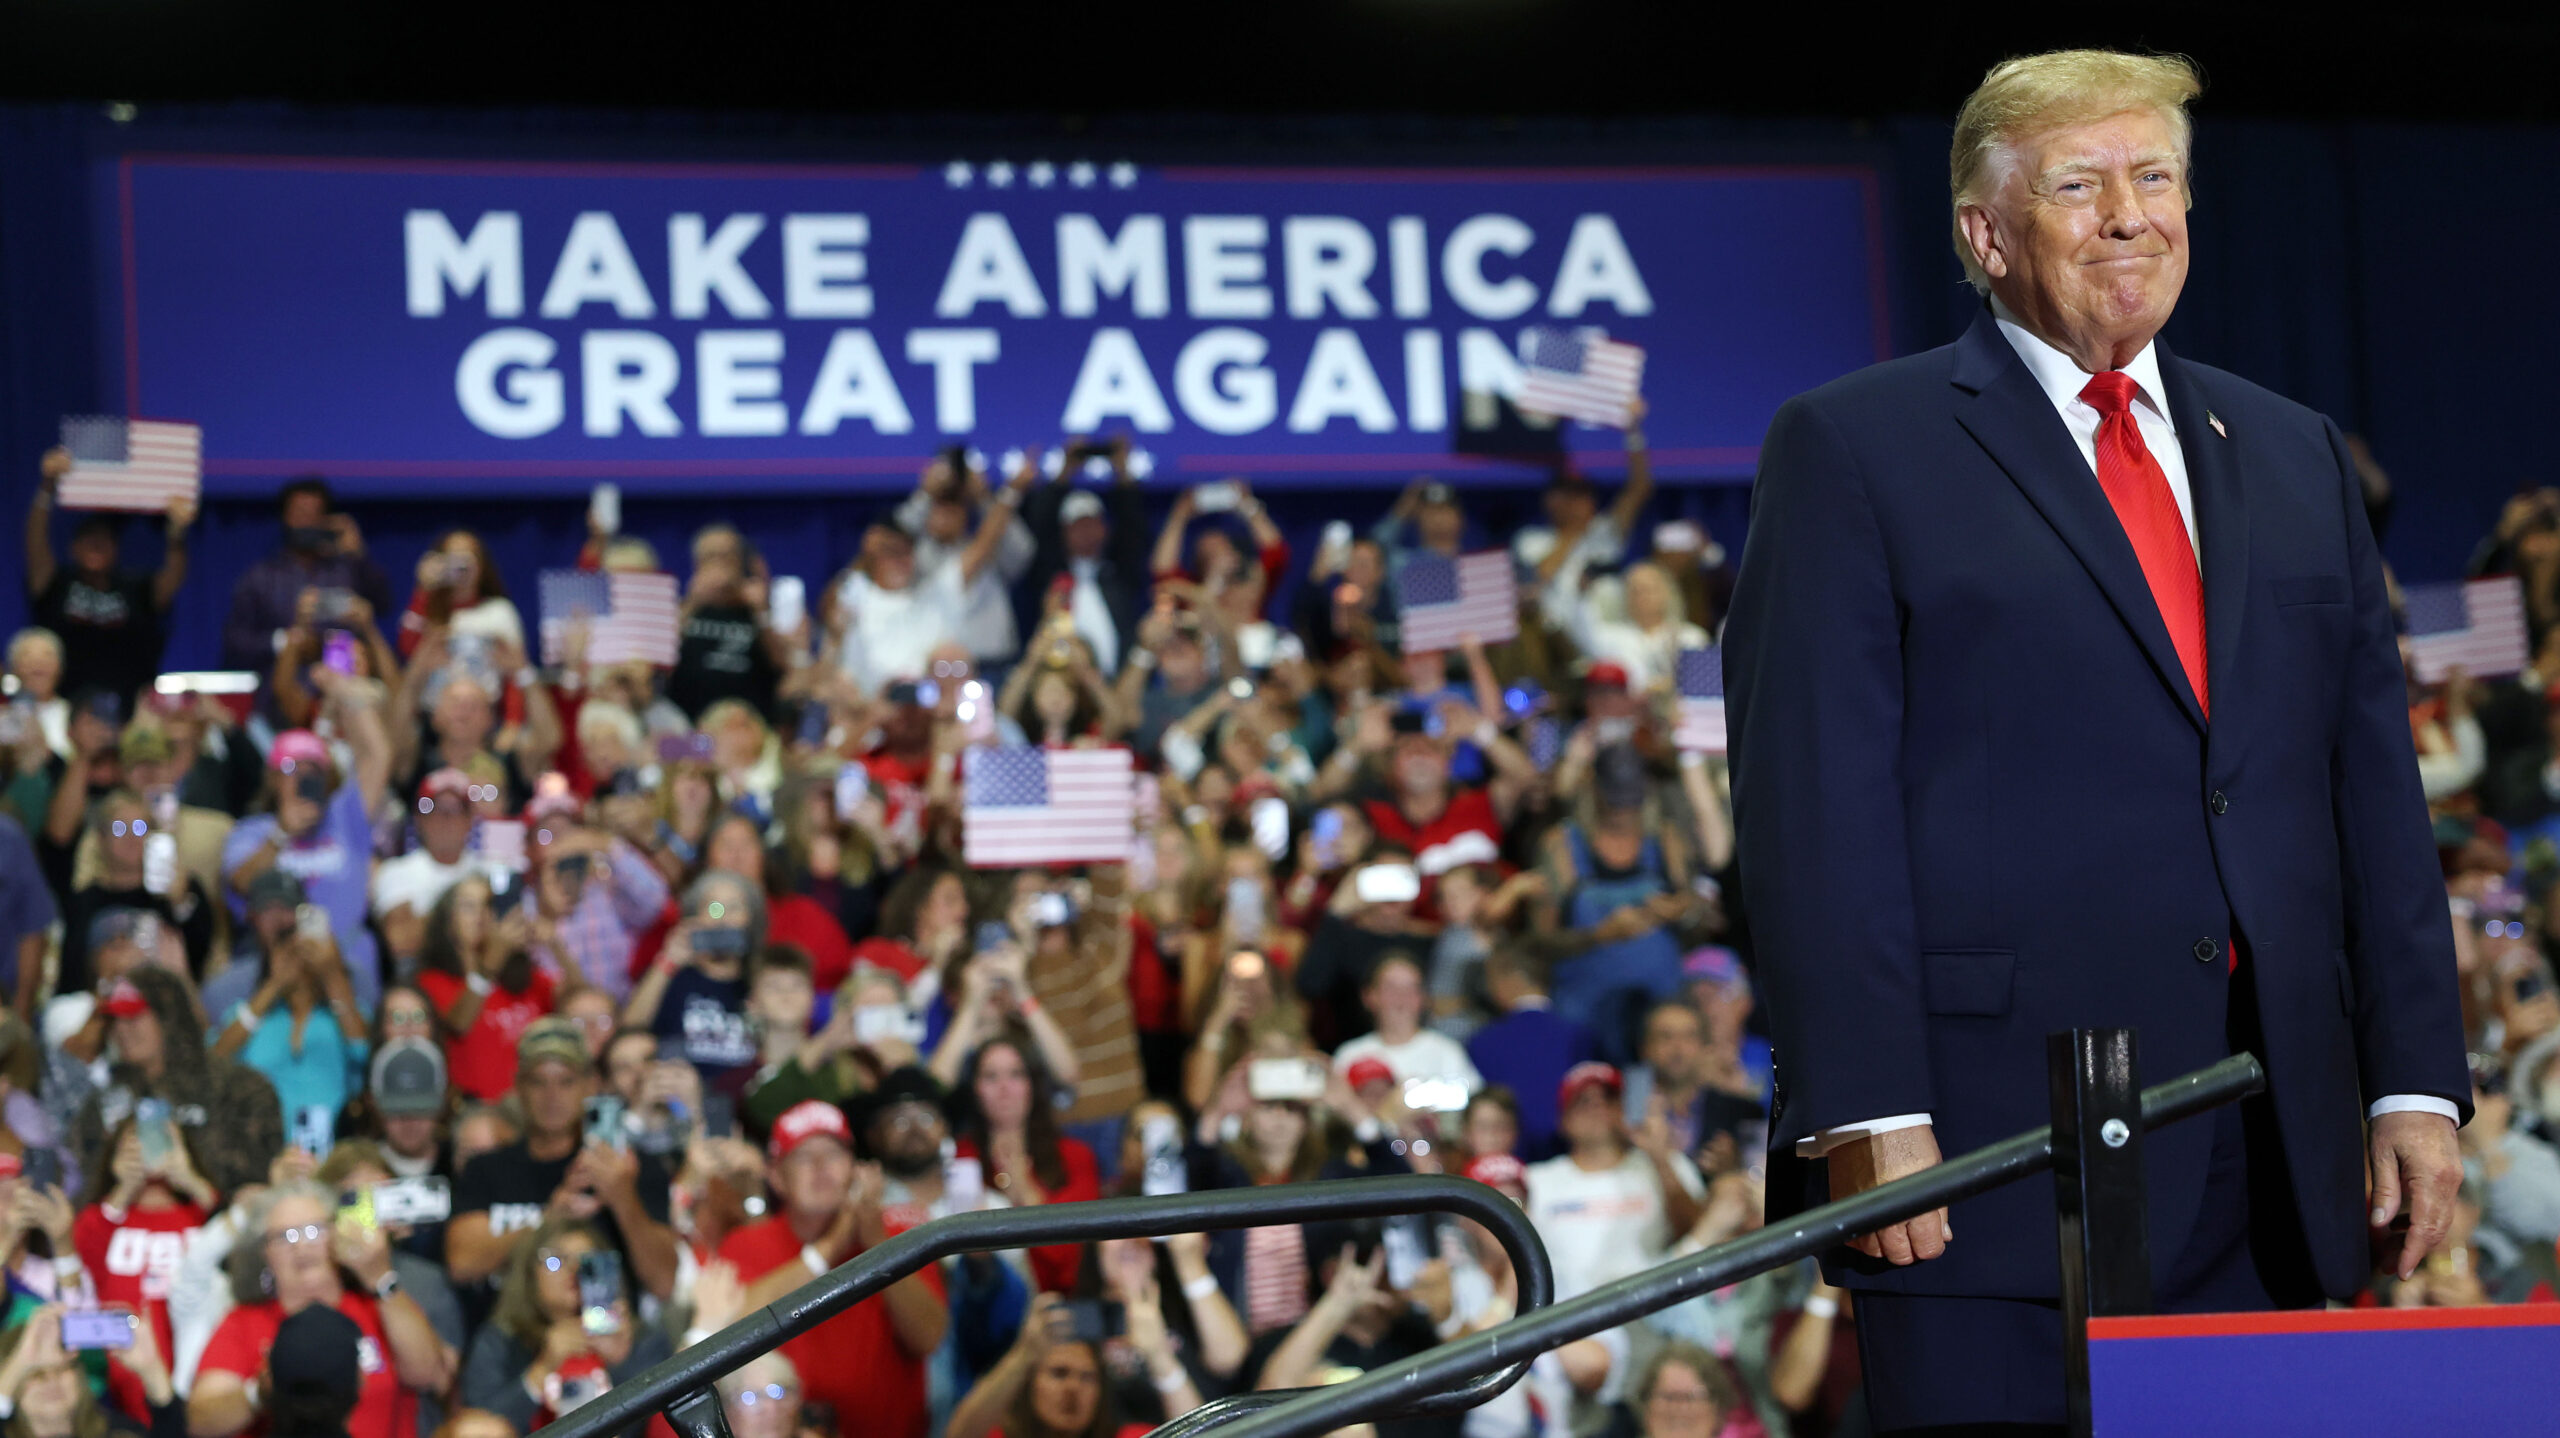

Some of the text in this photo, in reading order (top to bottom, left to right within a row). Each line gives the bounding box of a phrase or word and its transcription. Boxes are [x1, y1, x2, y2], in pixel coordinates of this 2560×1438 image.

[404, 210, 1652, 318] MAKE AMERICA
[456, 328, 1000, 438] GREAT
